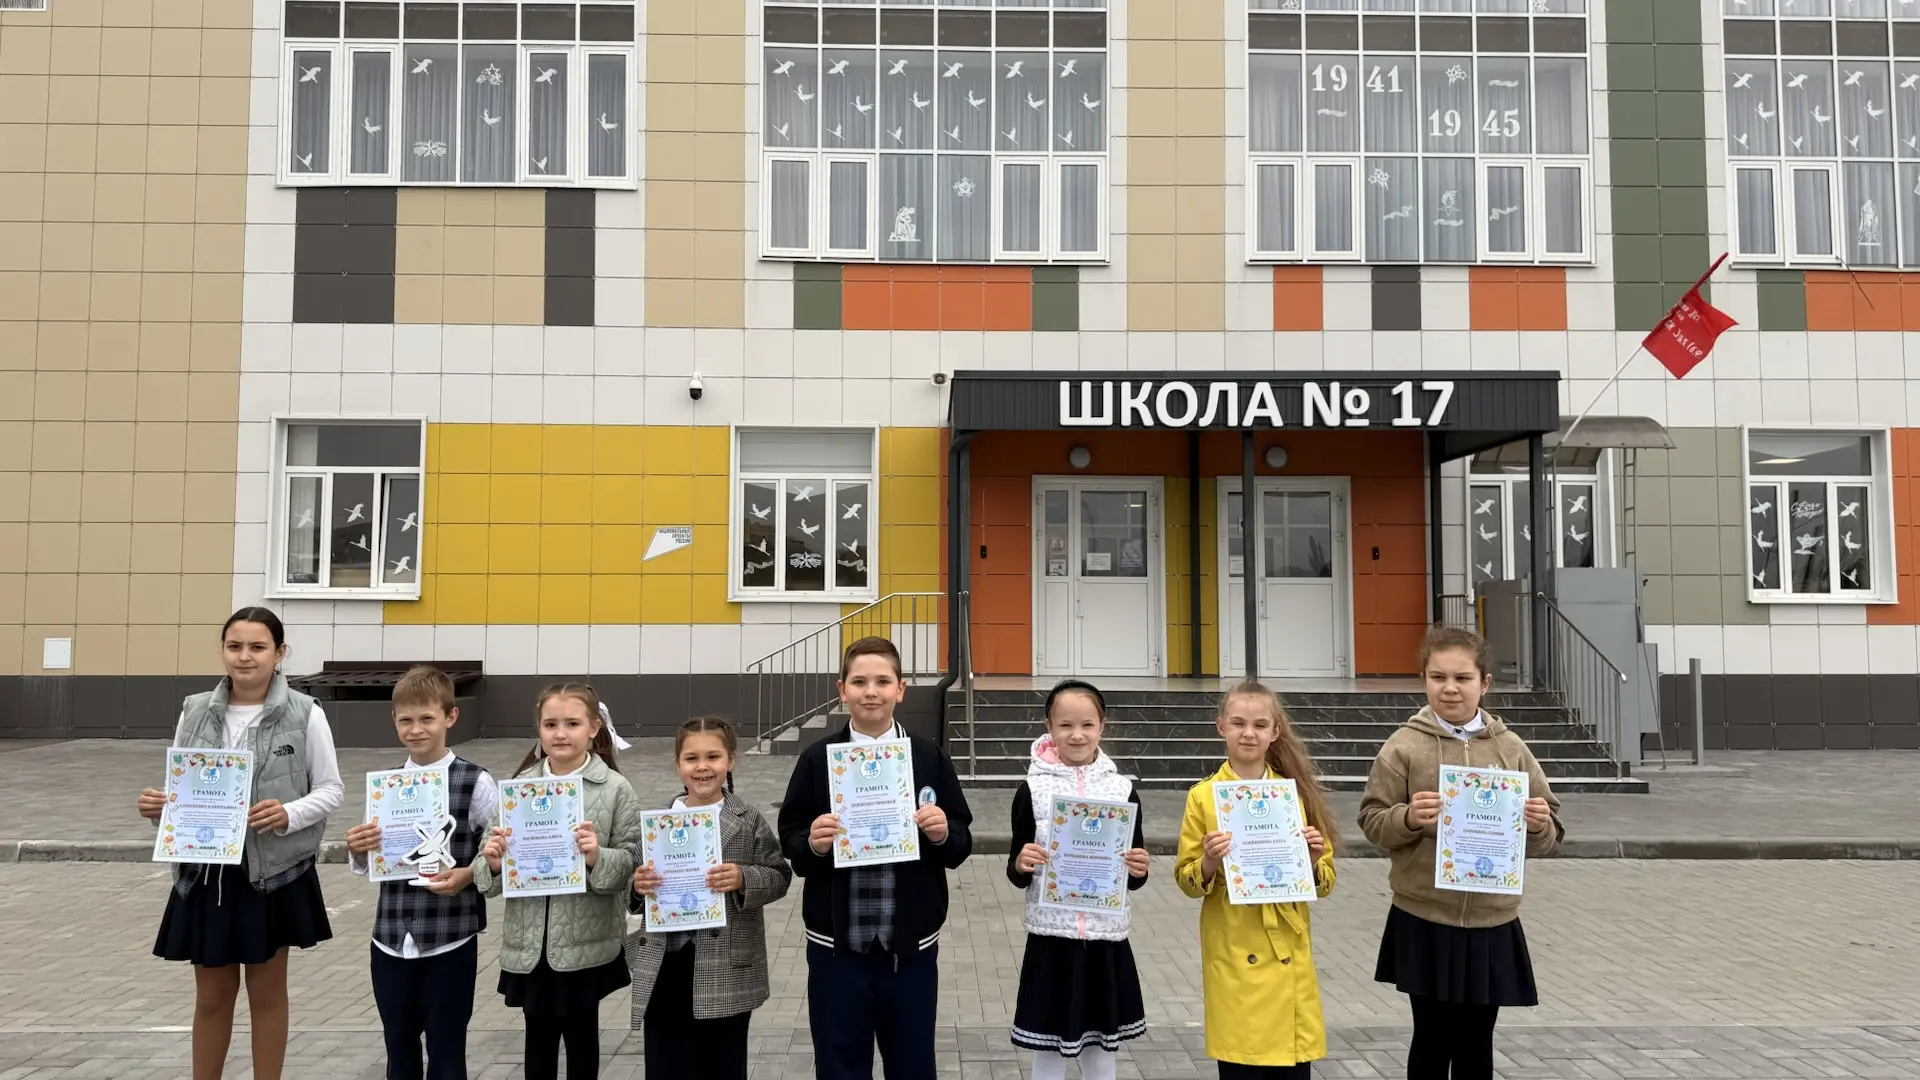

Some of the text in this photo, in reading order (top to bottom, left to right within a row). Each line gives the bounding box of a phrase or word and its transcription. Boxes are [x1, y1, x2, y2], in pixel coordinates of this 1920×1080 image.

[1311, 64, 1403, 93] 19 41
[1428, 108, 1520, 138] 19 45
[1059, 380, 1455, 427] ШКОЛА № 17
[192, 789, 227, 797] ГРАМОТА
[855, 785, 889, 793] ГРАМОТА
[391, 808, 425, 816] ГРАМОТА
[1466, 813, 1502, 822] ГРАМОТА
[525, 820, 559, 828] ГРАМОТА
[1244, 823, 1280, 831] ГРАМОТА
[1072, 840, 1106, 848] ГРАМОТА
[664, 852, 696, 861] ГРАМОТА
